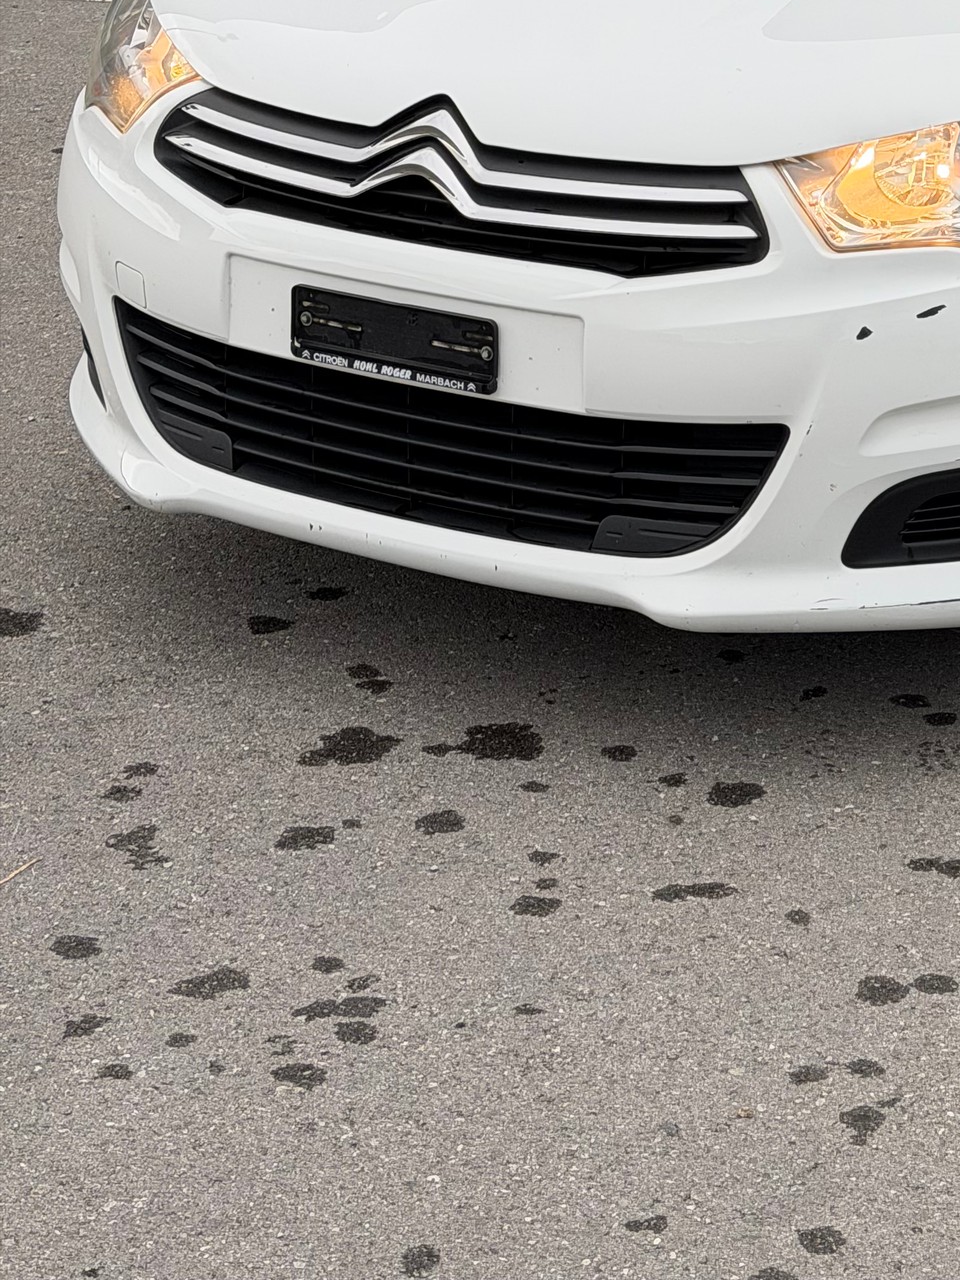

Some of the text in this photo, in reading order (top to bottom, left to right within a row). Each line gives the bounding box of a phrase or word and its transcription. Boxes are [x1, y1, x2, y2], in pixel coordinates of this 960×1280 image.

[313, 353, 465, 390] CITROËN HOHL ROGER MARBACH
